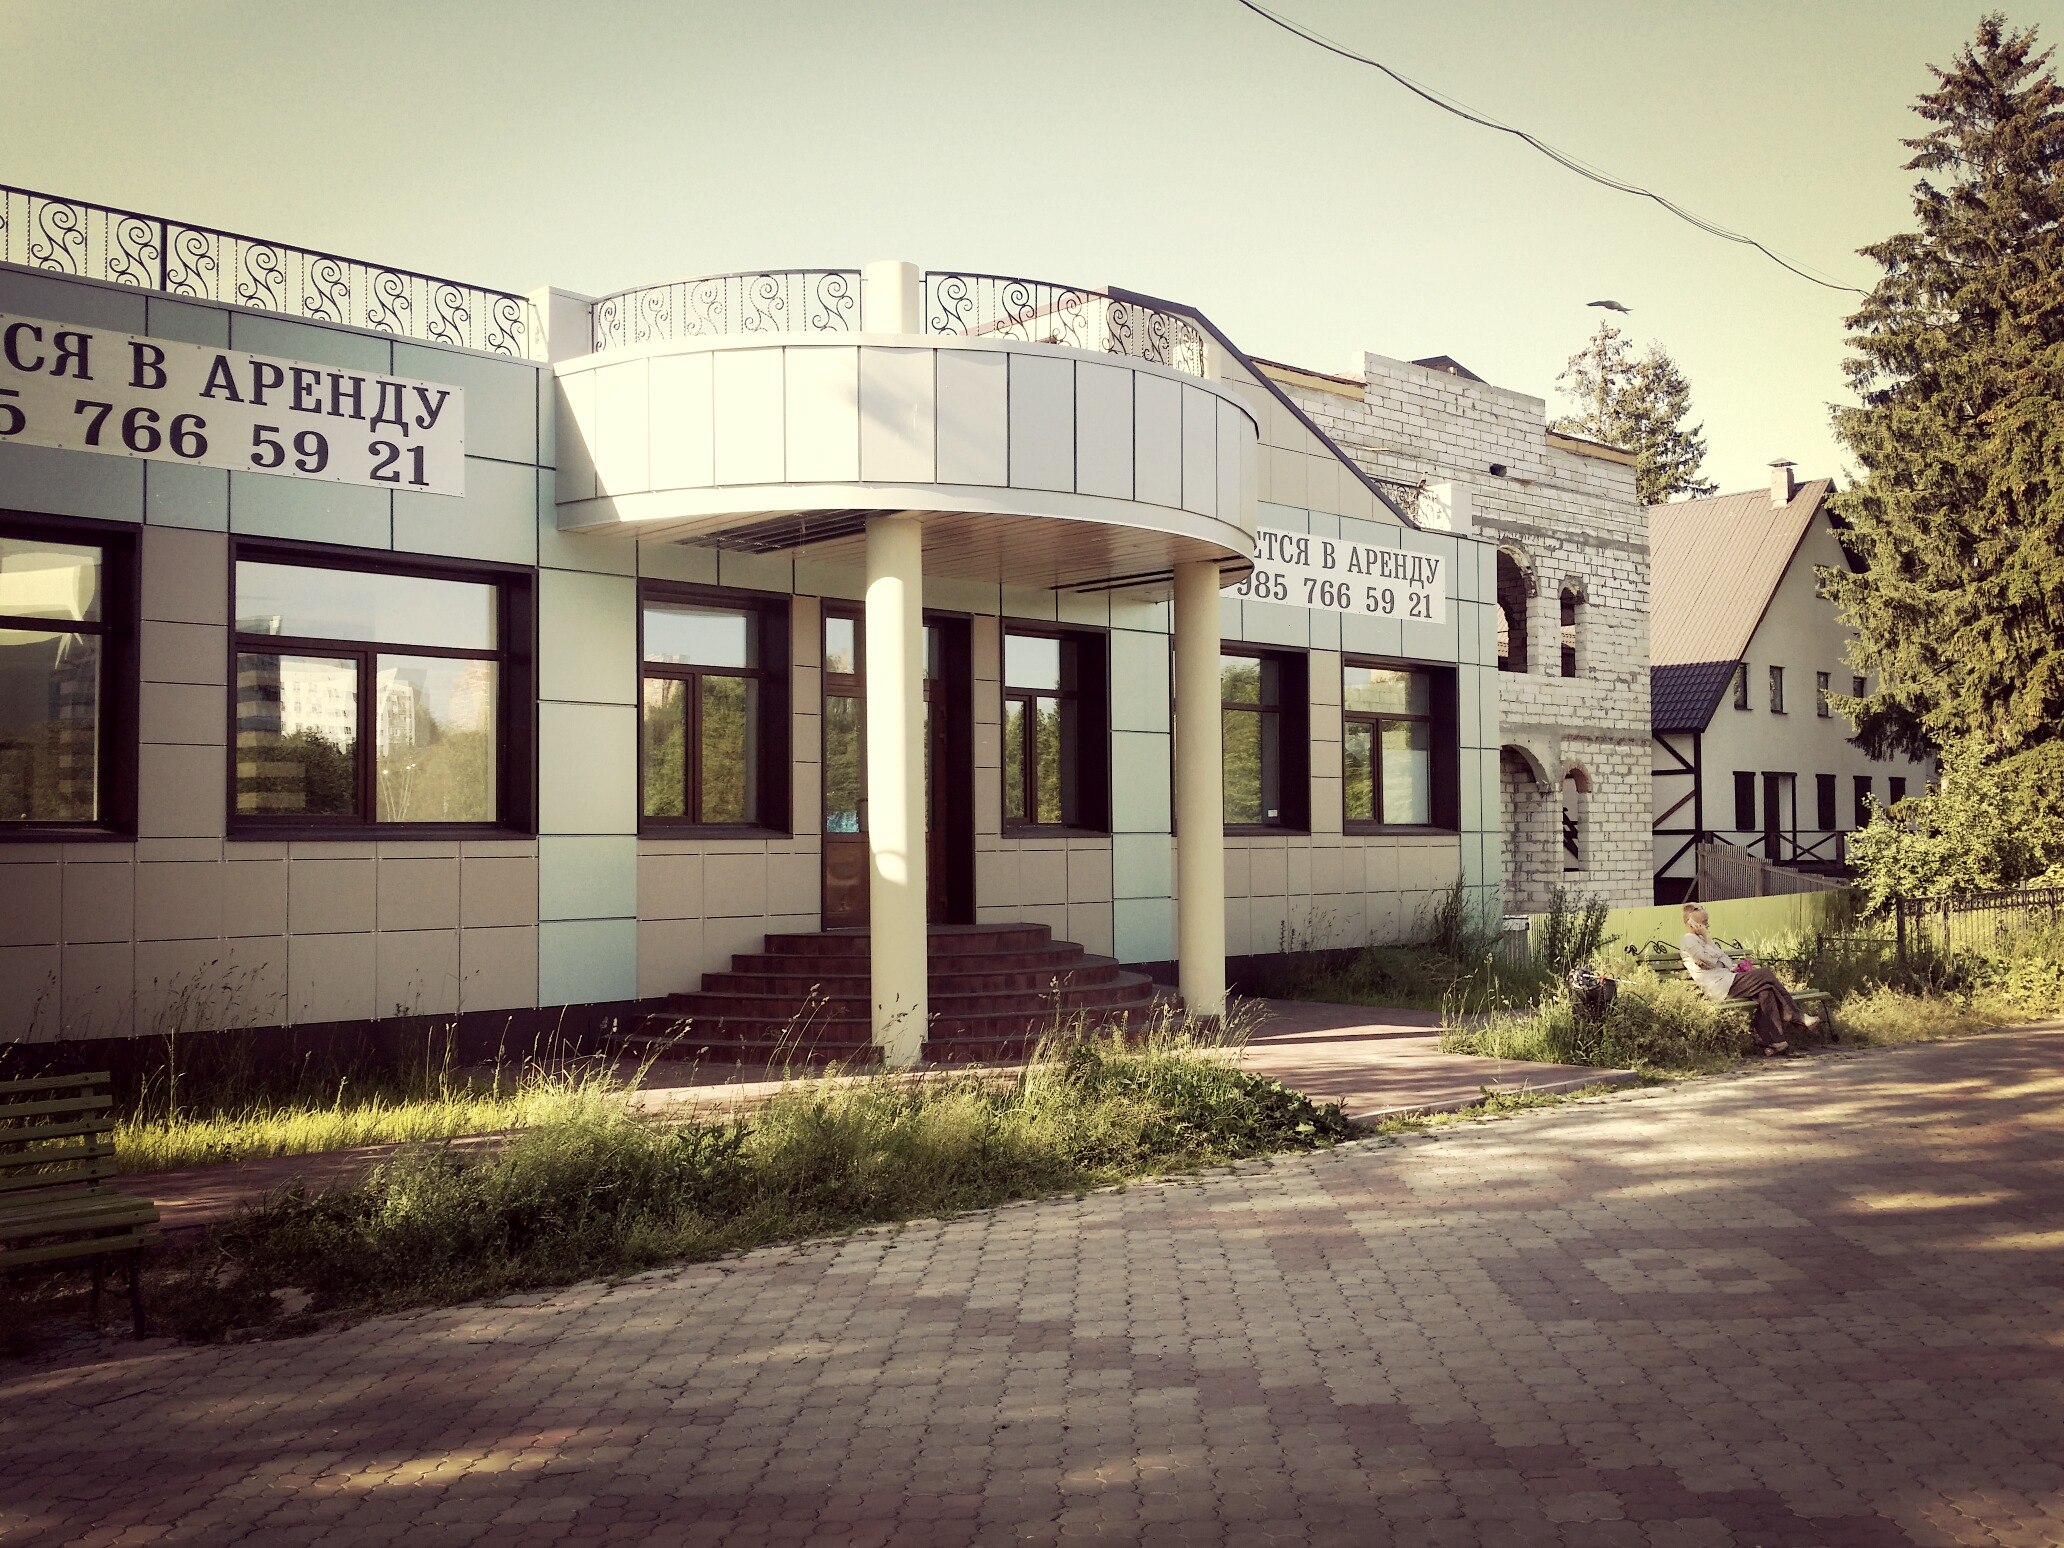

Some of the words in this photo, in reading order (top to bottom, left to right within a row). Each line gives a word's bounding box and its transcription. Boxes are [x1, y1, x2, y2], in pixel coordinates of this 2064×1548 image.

[127, 340, 168, 390] В
[198, 354, 451, 438] АРЕНДУ
[73, 398, 208, 459] 766
[250, 423, 329, 474] 59
[368, 440, 430, 487] 21
[1303, 577, 1351, 609] 766
[1365, 586, 1395, 615] 59
[1408, 592, 1433, 619] 21
[1321, 541, 1336, 570] В
[1346, 546, 1440, 590] АРЕНДУ
